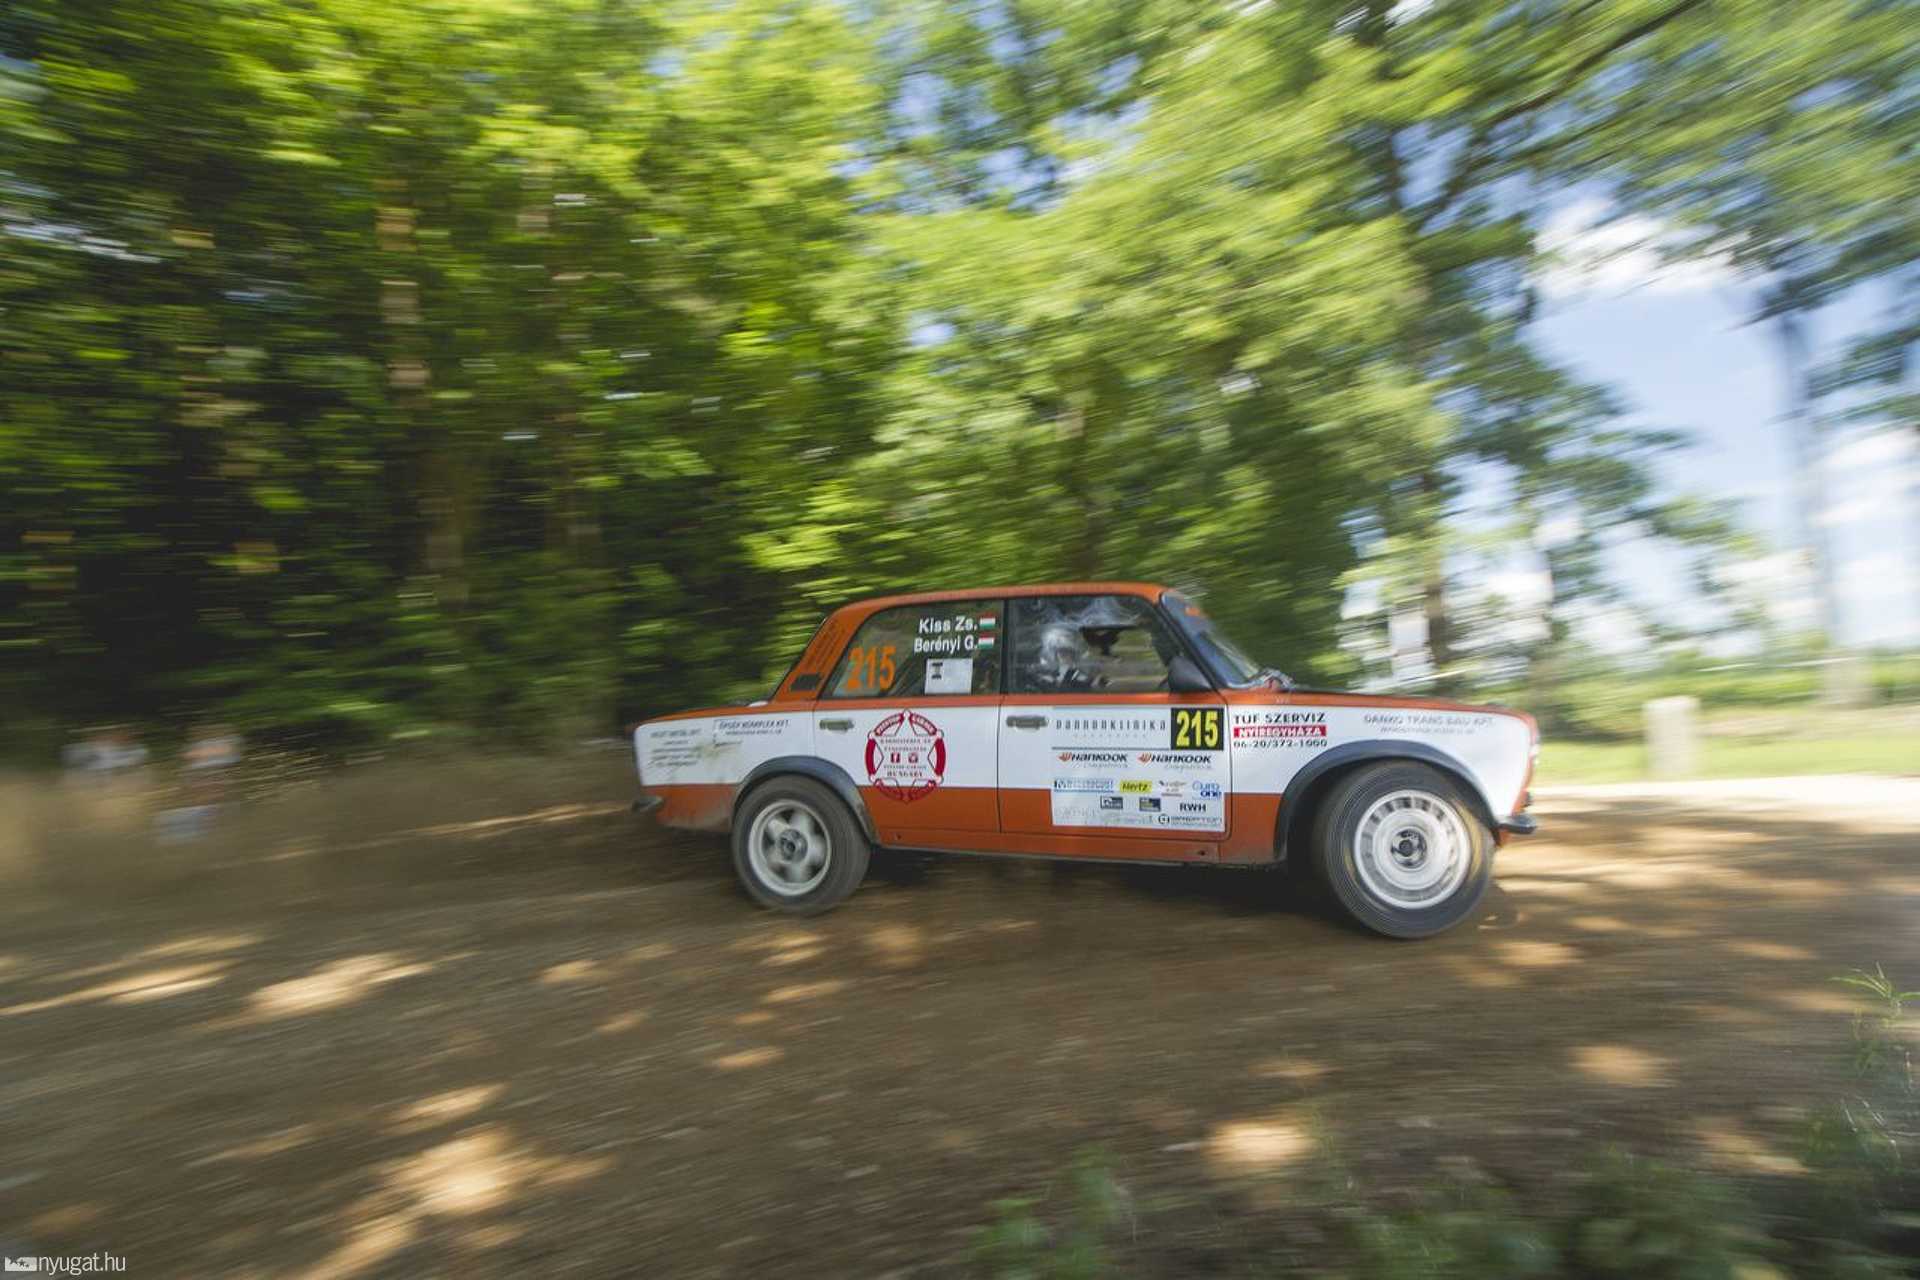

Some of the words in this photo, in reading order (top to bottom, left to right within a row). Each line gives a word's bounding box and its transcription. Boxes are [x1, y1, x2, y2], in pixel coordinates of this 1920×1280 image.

[918, 617, 950, 634] Kiss
[955, 615, 978, 631] Zs.
[914, 636, 961, 654] Berényi
[847, 645, 896, 690] 215
[1265, 712, 1325, 723] SZERVIZ
[1176, 709, 1219, 748] 215
[1122, 782, 1147, 792] Hertz
[1180, 802, 1206, 812] RWH
